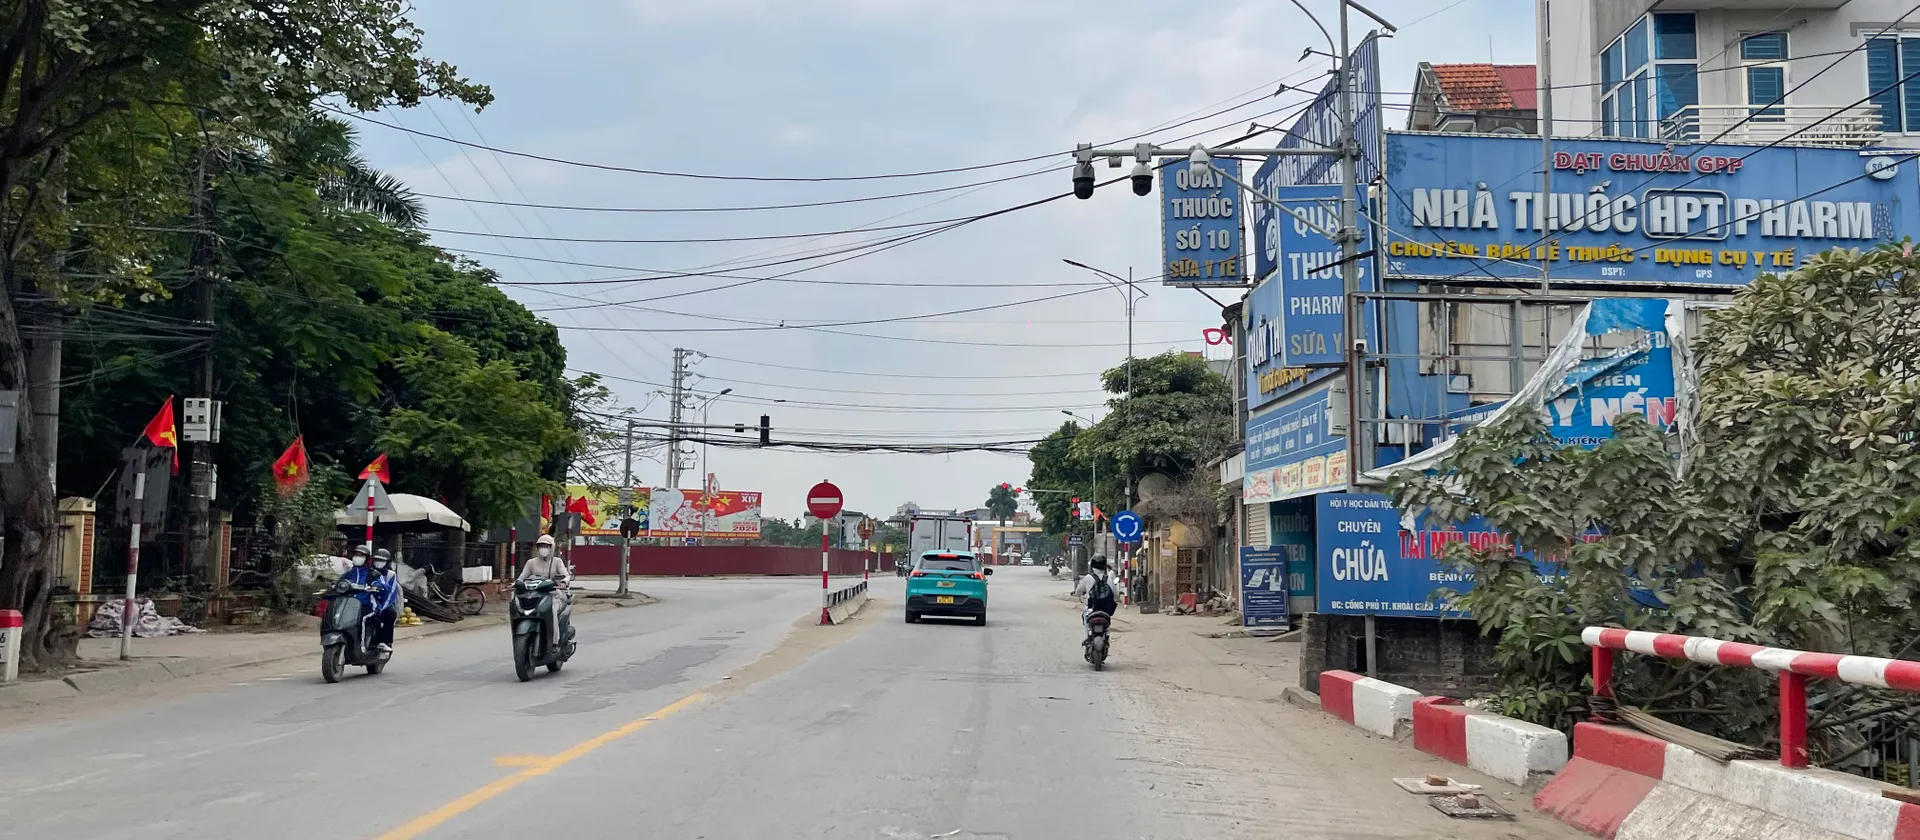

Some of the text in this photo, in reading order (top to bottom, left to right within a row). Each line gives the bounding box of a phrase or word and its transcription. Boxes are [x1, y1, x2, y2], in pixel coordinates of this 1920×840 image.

[1553, 143, 1743, 174] ĐẠT CHUẨN GPP
[1171, 190, 1233, 218] THUỐC
[1413, 182, 1498, 229] NHÀ
[1509, 180, 1637, 233] THUỐC
[1649, 195, 1723, 235] HPT
[1176, 223, 1230, 250] SỐ 10
[1169, 255, 1237, 277] SỮA Y TẾ
[1389, 241, 1480, 258] CHUYÊN:
[1486, 243, 1530, 260] BÁN
[1566, 243, 1635, 262] THUỐC
[1655, 249, 1712, 267] DỤNG
[1719, 250, 1747, 269] CỤ
[1753, 252, 1765, 267] Y
[1770, 247, 1796, 267] TẾ
[1291, 329, 1327, 356] SỮA
[1332, 332, 1343, 354] Y
[1591, 387, 1677, 427] NẾN
[1330, 498, 1342, 509] HỘI
[1342, 500, 1348, 508] Y
[1349, 500, 1363, 510] HỌC
[1364, 499, 1379, 509] DÂN
[1381, 499, 1394, 510] TỘC
[1338, 518, 1381, 533] CHUYÊN
[1397, 530, 1426, 560] TAI
[1332, 540, 1389, 582] CHỮA
[1428, 571, 1462, 584] BỆNH
[1344, 598, 1363, 610] CỐNG
